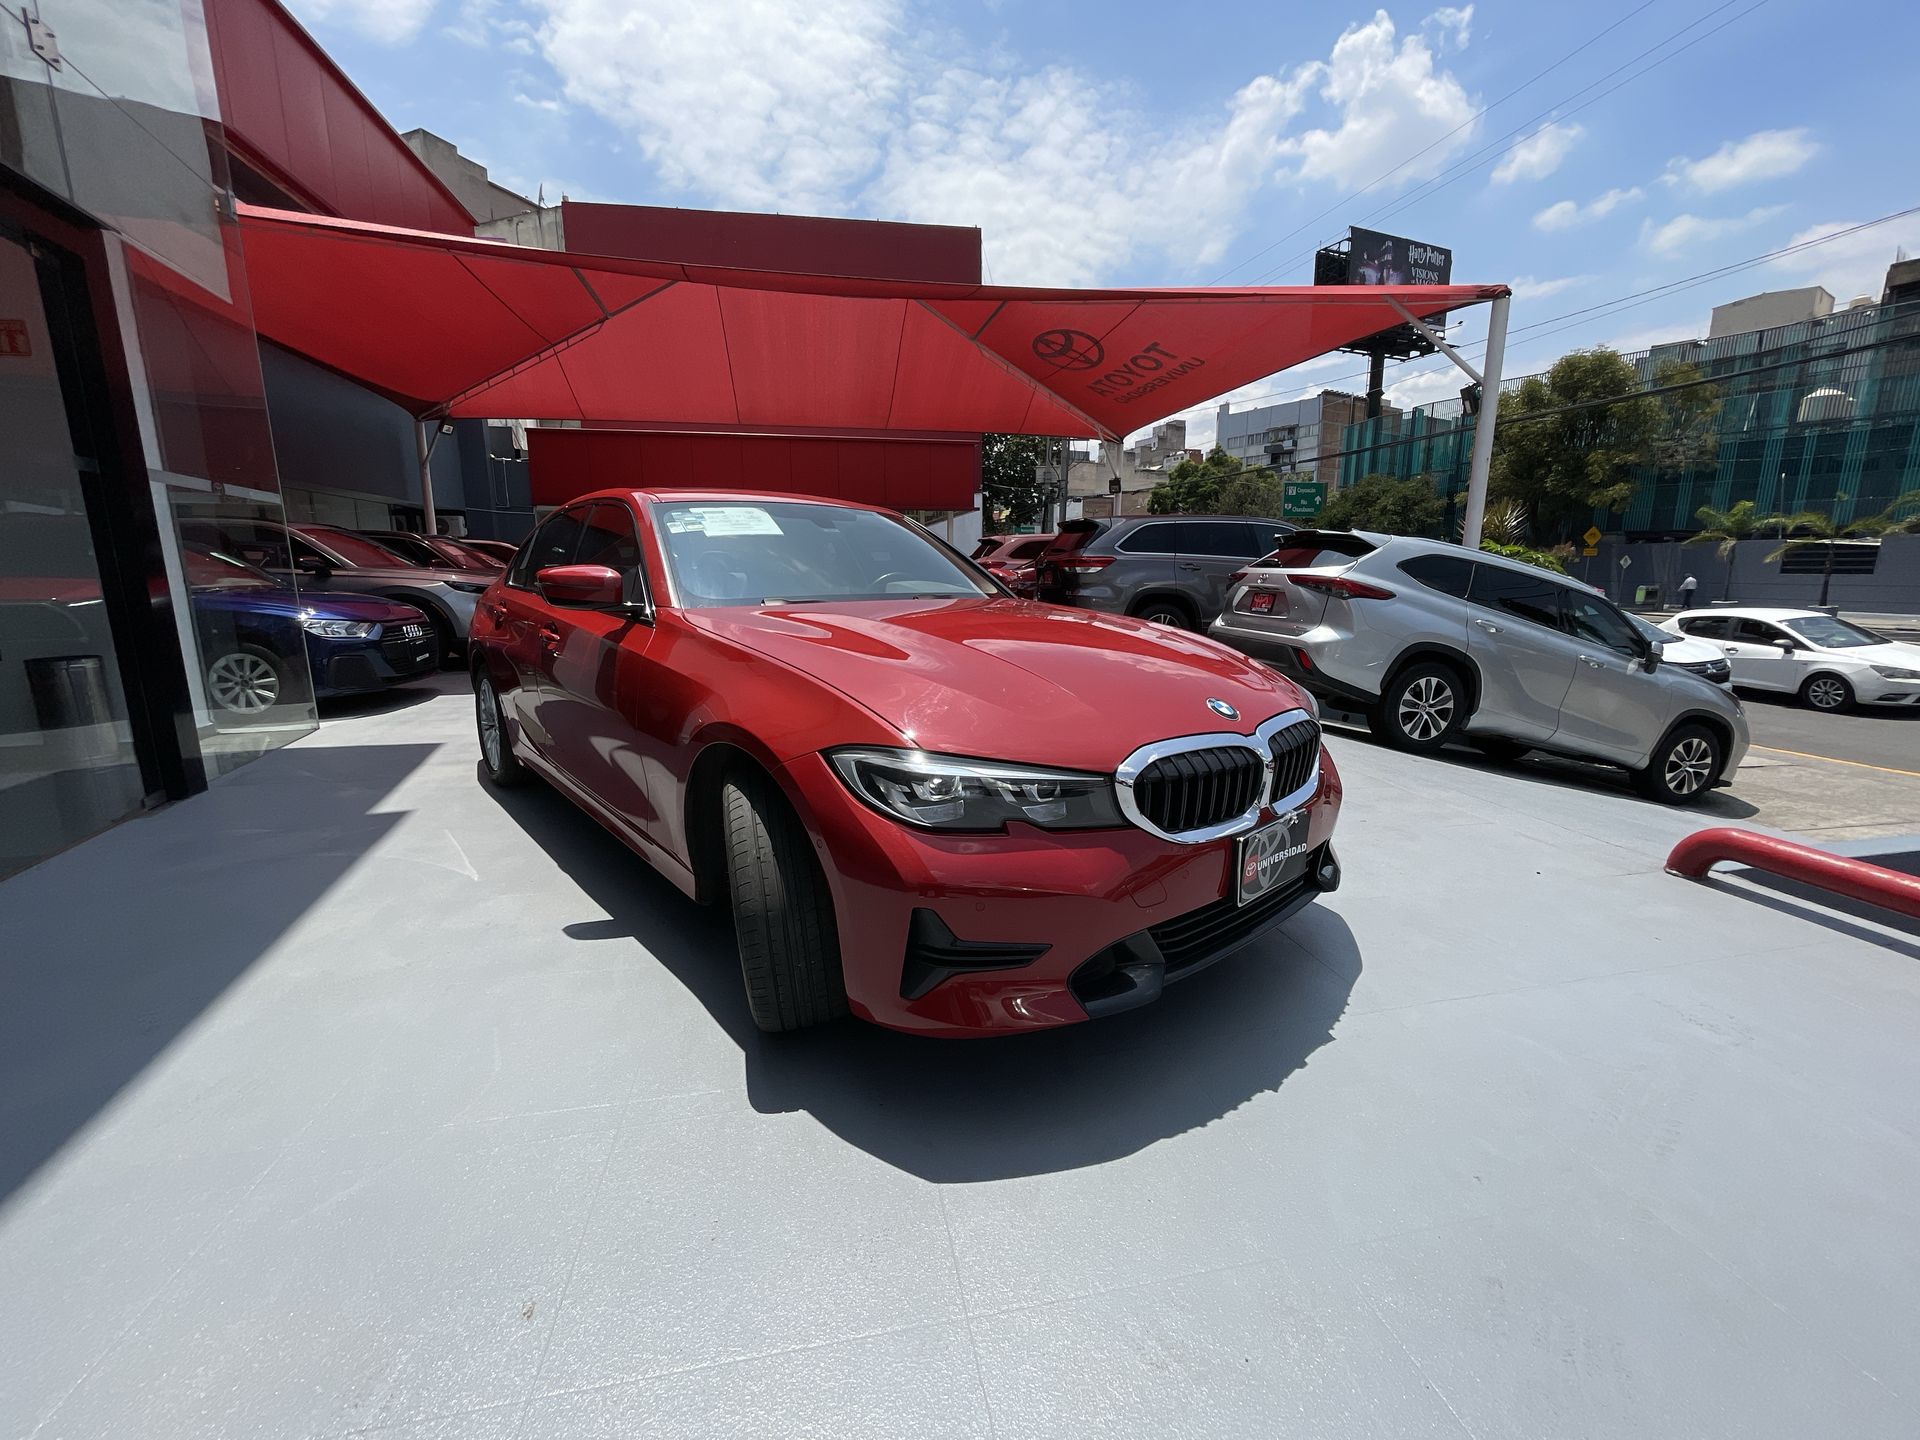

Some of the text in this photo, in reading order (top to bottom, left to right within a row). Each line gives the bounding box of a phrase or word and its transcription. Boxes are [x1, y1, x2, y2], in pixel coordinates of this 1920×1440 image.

[1408, 244, 1445, 267] Harry Potter
[1411, 266, 1439, 282] VISIONS
[1257, 843, 1307, 870] UNIVERSIDAD
